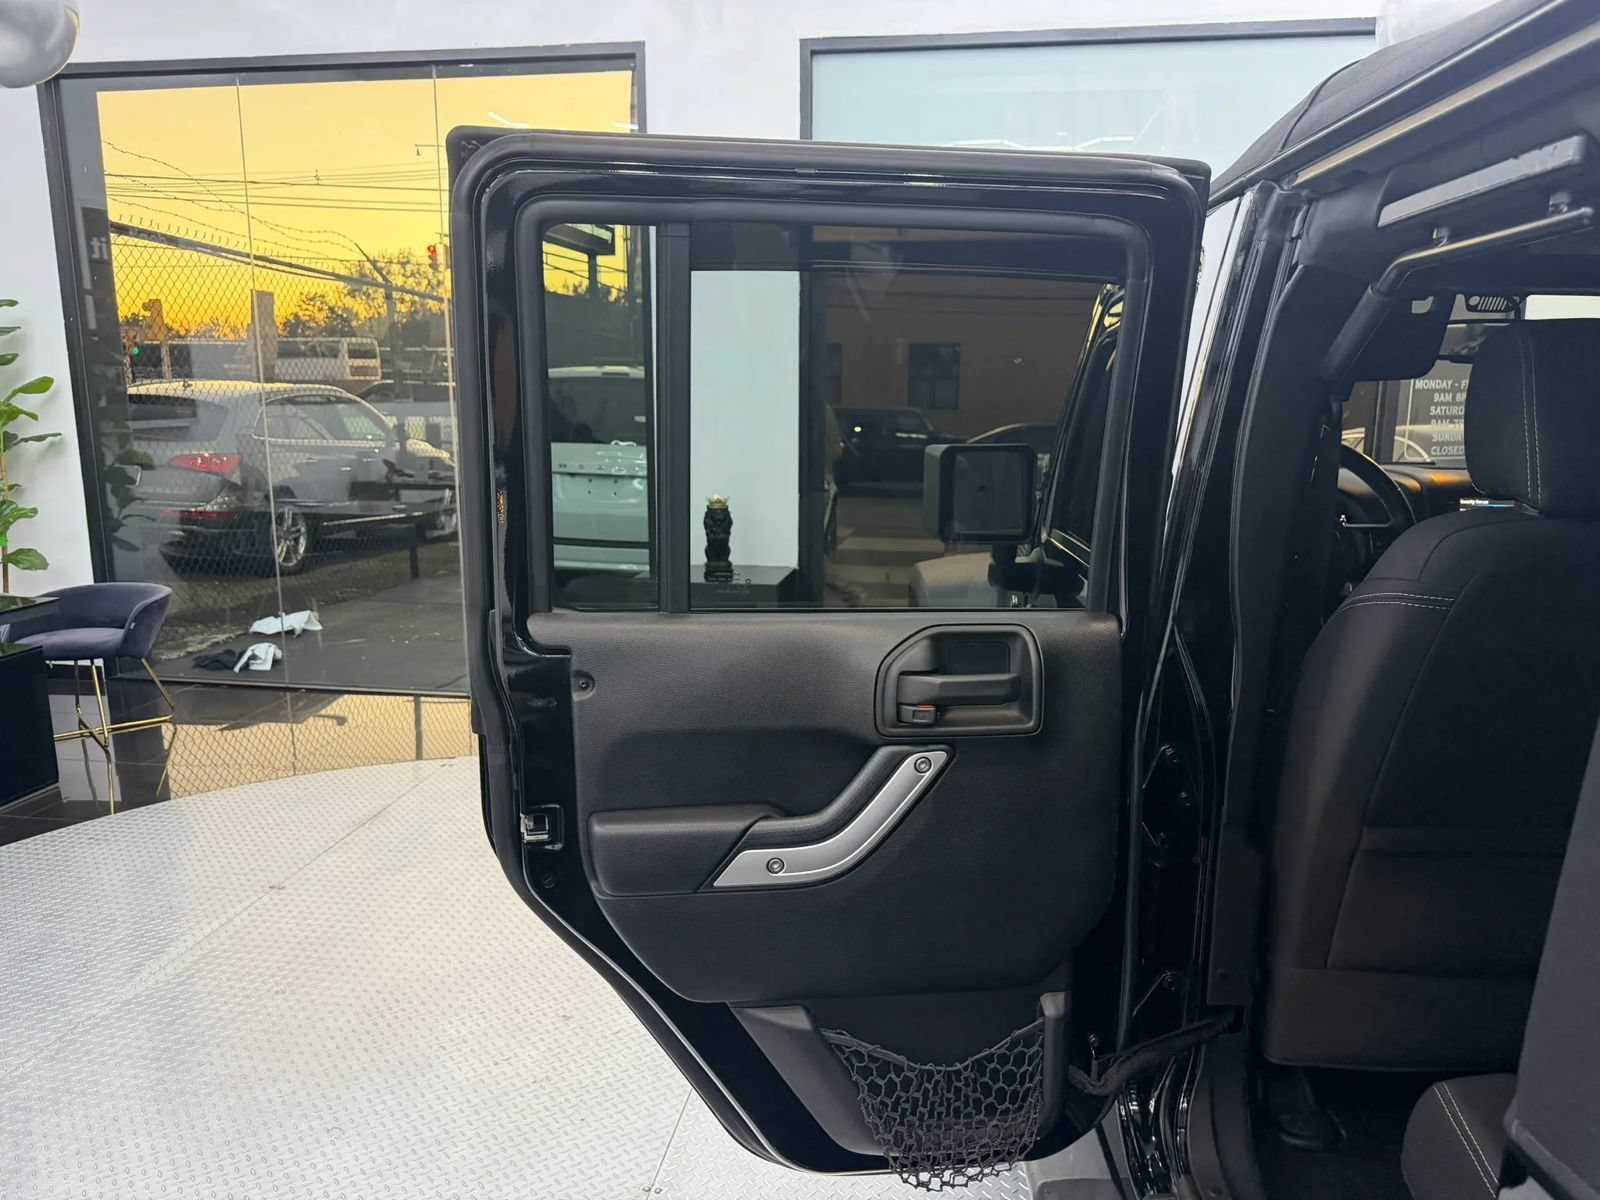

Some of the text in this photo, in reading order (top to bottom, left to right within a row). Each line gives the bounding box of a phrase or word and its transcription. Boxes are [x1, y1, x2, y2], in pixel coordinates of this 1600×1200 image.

[1414, 379, 1453, 390] MONDAY
[1433, 392, 1453, 402] 9AM
[1431, 431, 1464, 442] SUNDA
[1431, 445, 1465, 456] CLOSED
